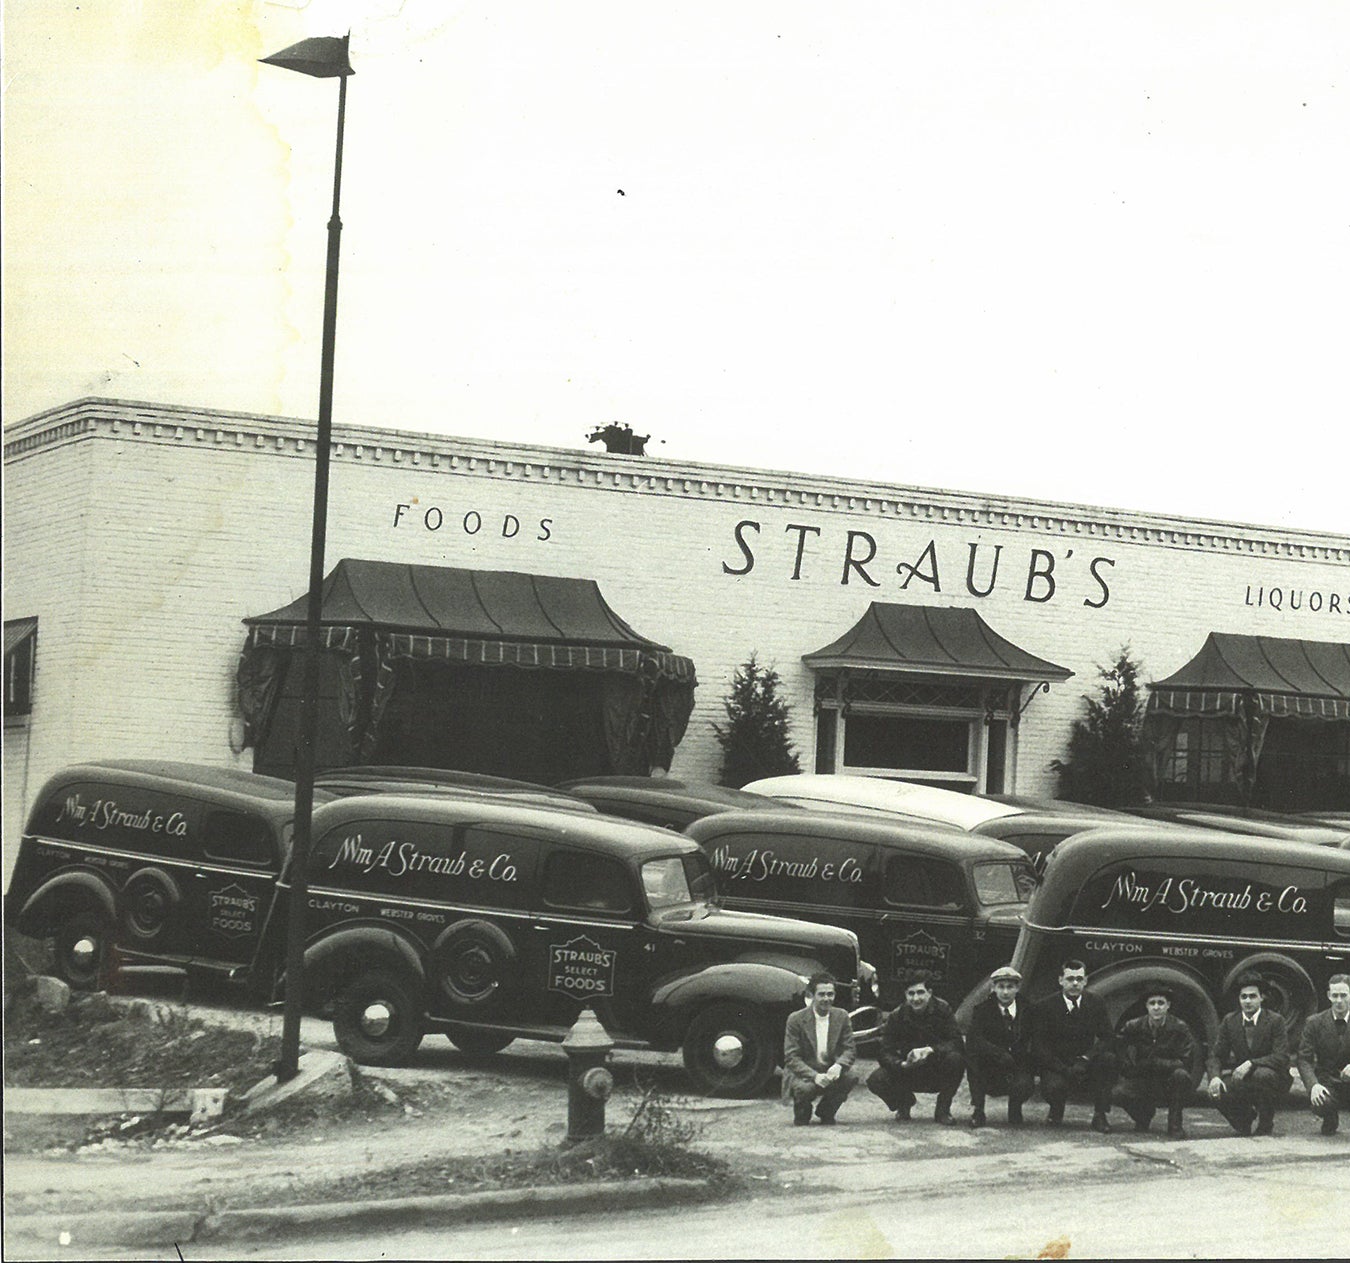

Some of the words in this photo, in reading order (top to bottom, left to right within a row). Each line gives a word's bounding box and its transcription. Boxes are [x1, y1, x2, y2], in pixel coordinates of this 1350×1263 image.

[393, 503, 553, 541] FOODS
[722, 519, 1116, 609] STRAUB'S
[79, 800, 102, 827] A
[99, 801, 151, 830] Straub
[152, 816, 164, 833] &
[328, 834, 373, 869] Wm
[363, 840, 396, 874] A
[387, 842, 467, 877] Straub
[468, 859, 485, 879] &
[488, 853, 518, 882] Co.
[731, 849, 758, 879] A
[752, 850, 818, 881] Straub
[821, 863, 834, 881] &
[838, 857, 863, 882] Co.
[1101, 872, 1149, 909] Wm
[1141, 877, 1173, 912] A
[1167, 879, 1252, 914] Straub
[1256, 892, 1273, 912] &
[1278, 885, 1308, 913] Co.
[308, 899, 360, 914] CLAYTON
[380, 908, 414, 920] WEBSTER
[416, 911, 446, 924] GROVES
[643, 943, 656, 953] 41
[1085, 941, 1143, 953] CLAYTON
[1162, 946, 1199, 957] WEBSTER
[1202, 949, 1234, 959] GROVES
[554, 975, 606, 991] FOODS
[564, 965, 598, 976] SELECT
